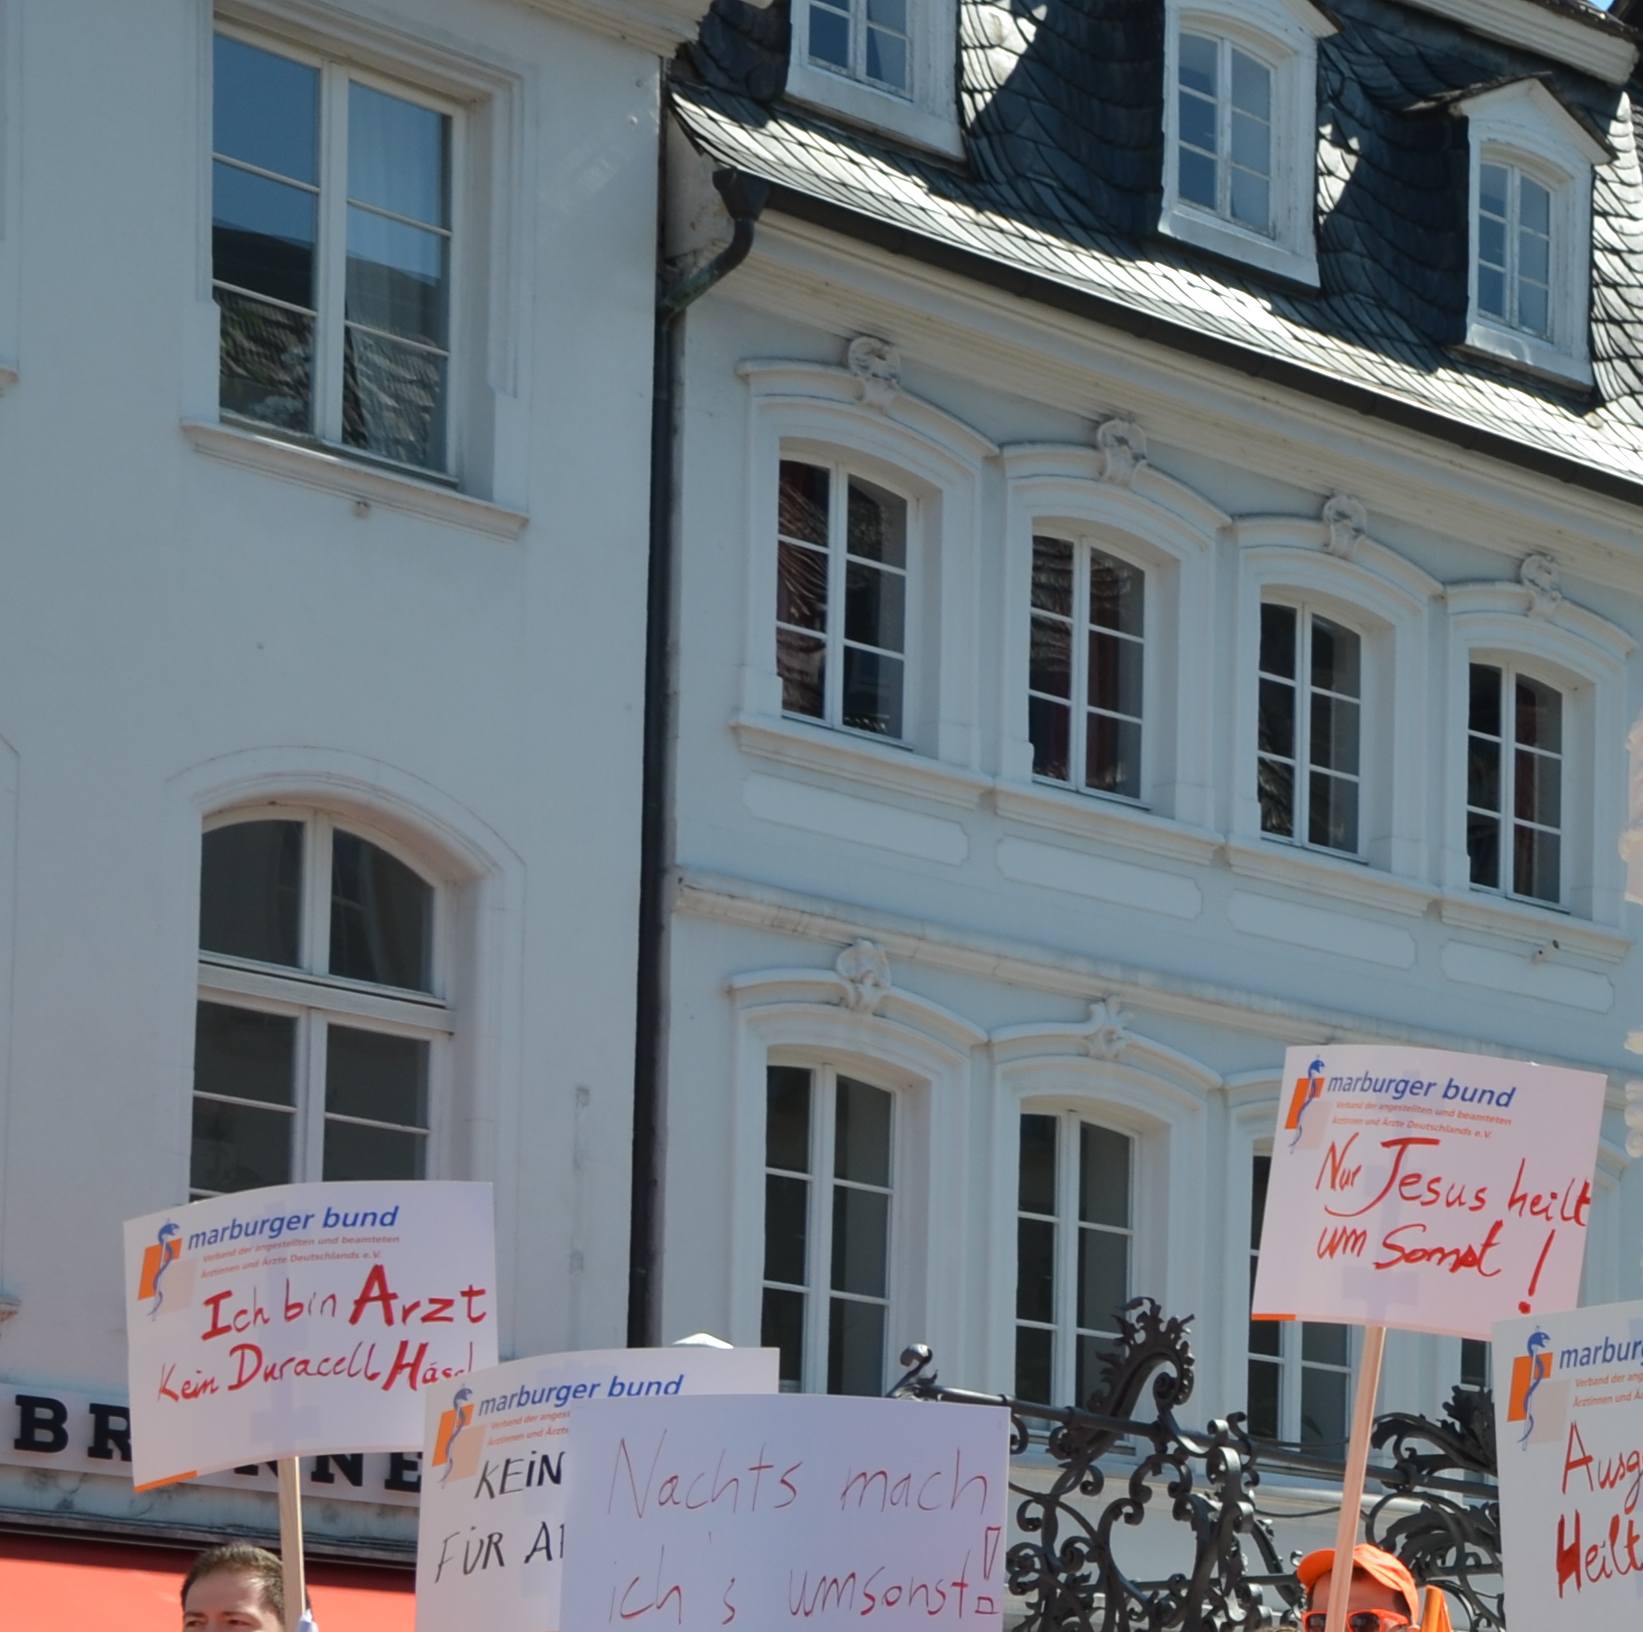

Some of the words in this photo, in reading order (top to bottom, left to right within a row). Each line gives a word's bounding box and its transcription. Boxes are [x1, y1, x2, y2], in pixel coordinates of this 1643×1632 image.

[1327, 1071, 1437, 1100] marburger
[1441, 1077, 1517, 1108] bund
[1435, 1108, 1455, 1118] und
[1457, 1110, 1512, 1126] beamteten
[1315, 1132, 1362, 1192] Nur
[1324, 1137, 1488, 1218] Jesus
[1508, 1158, 1591, 1228] heilt
[187, 1211, 314, 1251] marburger
[322, 1206, 400, 1229] bund
[201, 1286, 270, 1341] Ich
[283, 1278, 337, 1323] bin
[348, 1264, 487, 1327] Arzt
[158, 1362, 220, 1403] Kein
[228, 1341, 380, 1393] Duracell
[478, 1381, 600, 1416] marburger
[608, 1374, 684, 1397] bund
[1574, 1373, 1608, 1388] Verband
[1610, 1371, 1626, 1383] der
[1614, 1391, 1631, 1403] und
[608, 1428, 803, 1519] Nachts
[841, 1446, 988, 1515] mach
[434, 1526, 505, 1584] FÜR
[789, 1526, 1002, 1619] umsonst!
